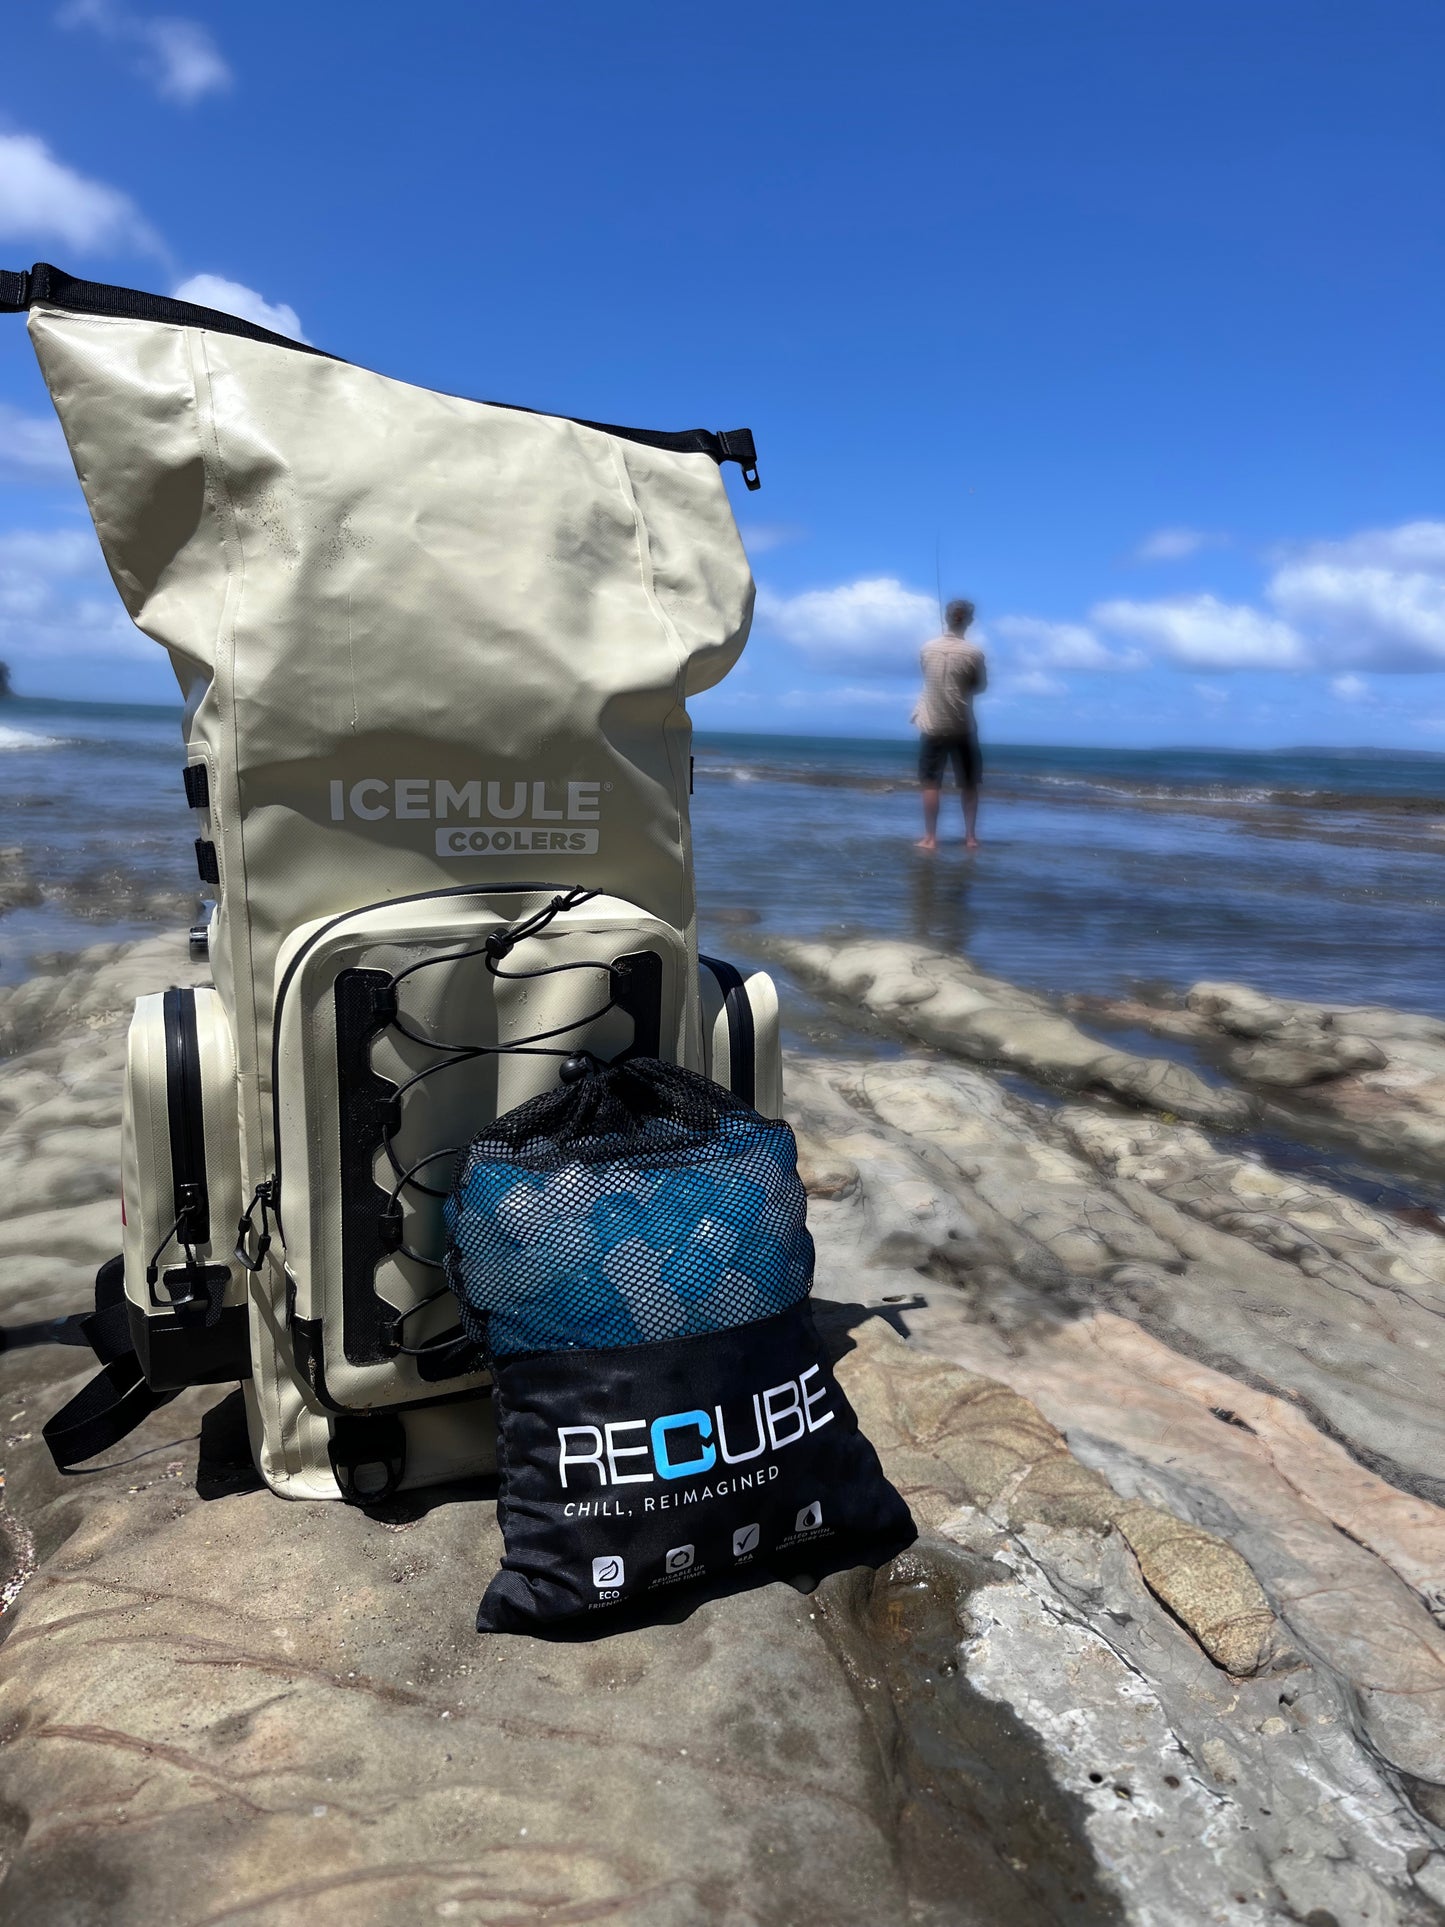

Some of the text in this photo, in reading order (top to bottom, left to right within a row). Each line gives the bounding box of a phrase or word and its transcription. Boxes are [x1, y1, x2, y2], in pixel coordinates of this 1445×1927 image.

[329, 778, 601, 821] ICEMULE
[448, 831, 587, 851] COOLERS
[557, 1363, 836, 1488] RECUBE
[563, 1465, 780, 1518] CHILL, REIMAGINED
[599, 1590, 621, 1600] ECO
